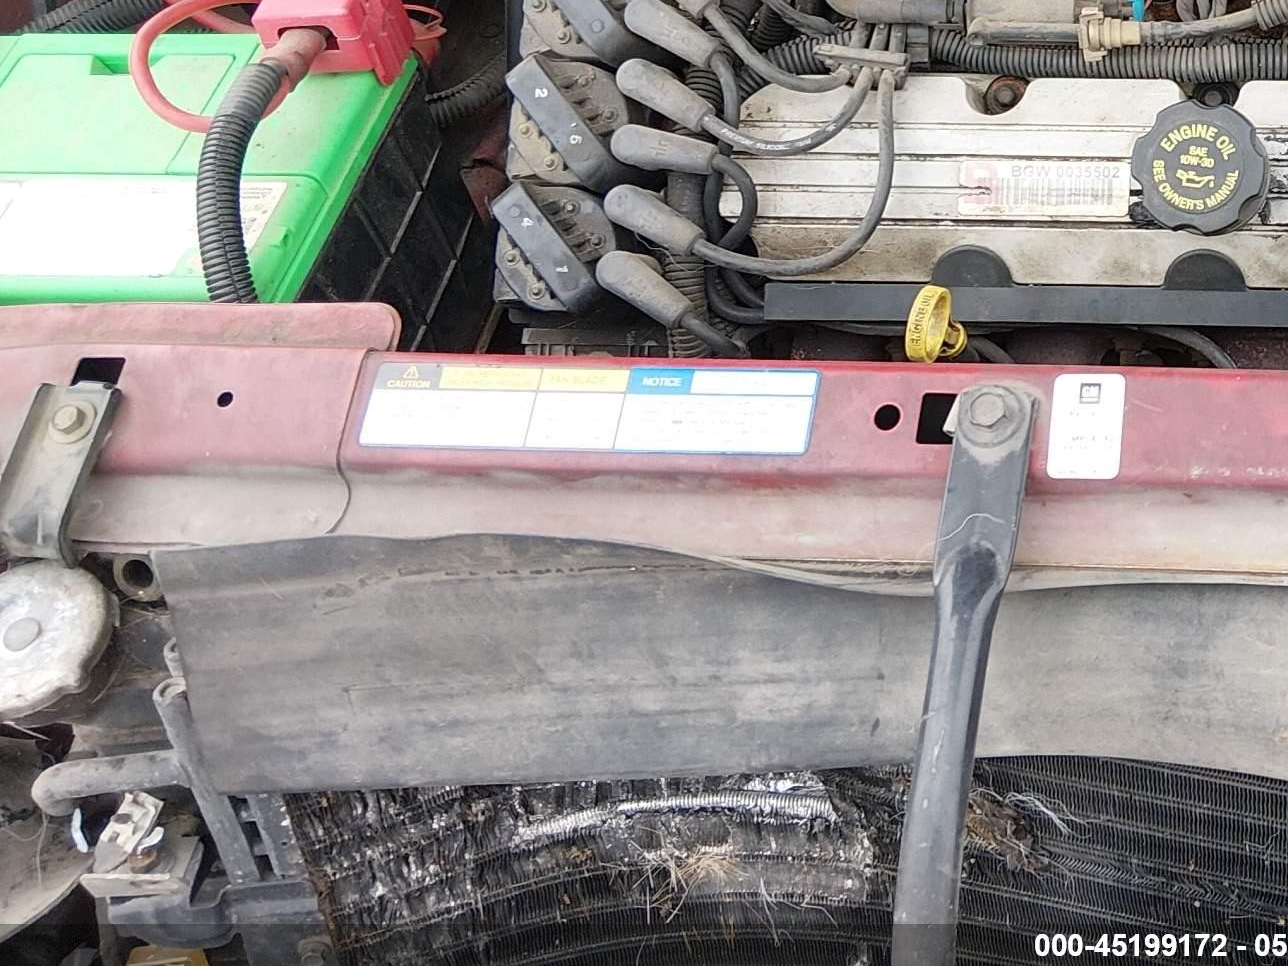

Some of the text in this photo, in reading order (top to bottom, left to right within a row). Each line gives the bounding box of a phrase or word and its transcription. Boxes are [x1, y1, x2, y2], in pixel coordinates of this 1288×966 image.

[535, 88, 548, 98] 2
[1160, 124, 1237, 161] ENGINE OIL
[1189, 146, 1208, 157] SAE
[1180, 154, 1215, 168] 10W-30
[1011, 165, 1121, 179] BGW 0035502
[1152, 160, 1239, 211] SEE OWNER'S MANUAL
[387, 379, 431, 388] CAUTION
[642, 377, 683, 387] NOTICE
